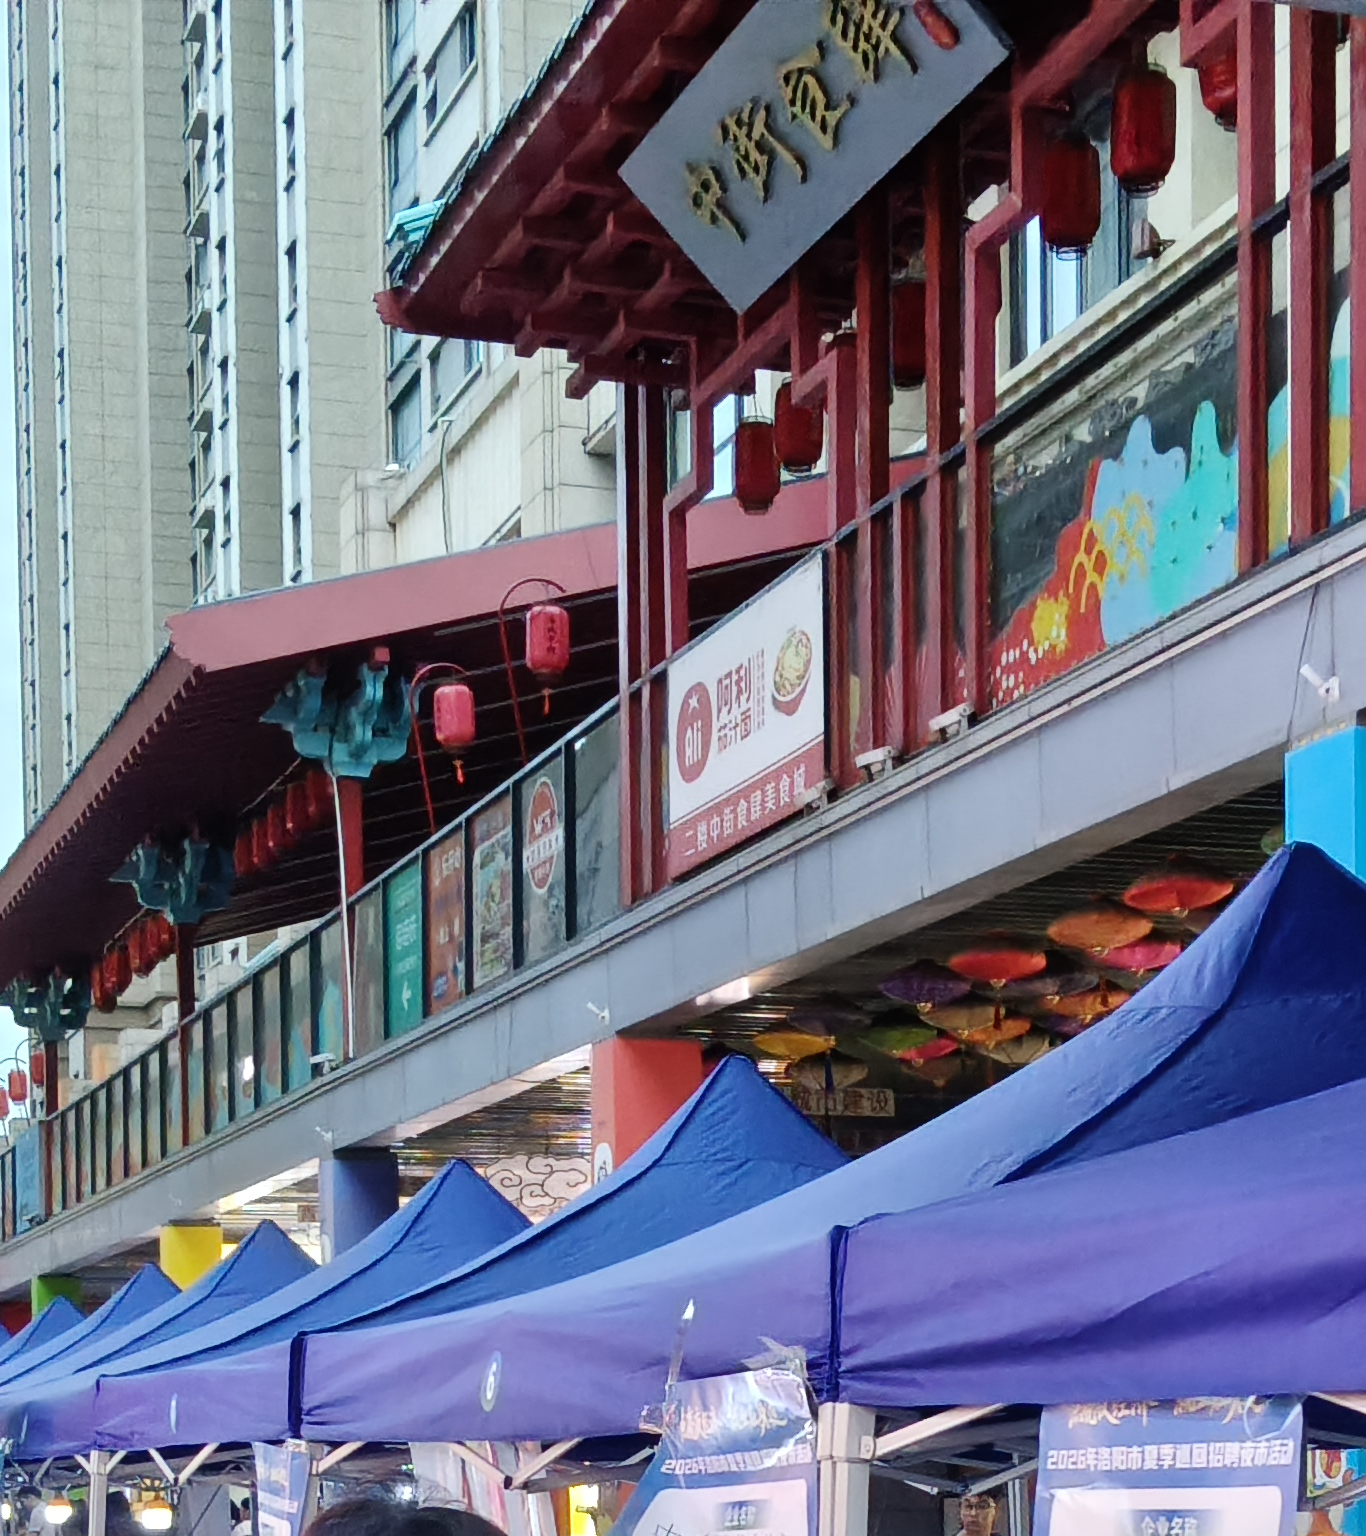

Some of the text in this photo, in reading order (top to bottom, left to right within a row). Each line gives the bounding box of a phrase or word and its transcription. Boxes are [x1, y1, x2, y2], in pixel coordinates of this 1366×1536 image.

[716, 657, 752, 723] 阿利
[685, 719, 702, 767] Ali
[486, 1360, 498, 1400] 6
[1046, 1437, 1295, 1472] 2026年洛阳市夏季巡回招聘夜市活动
